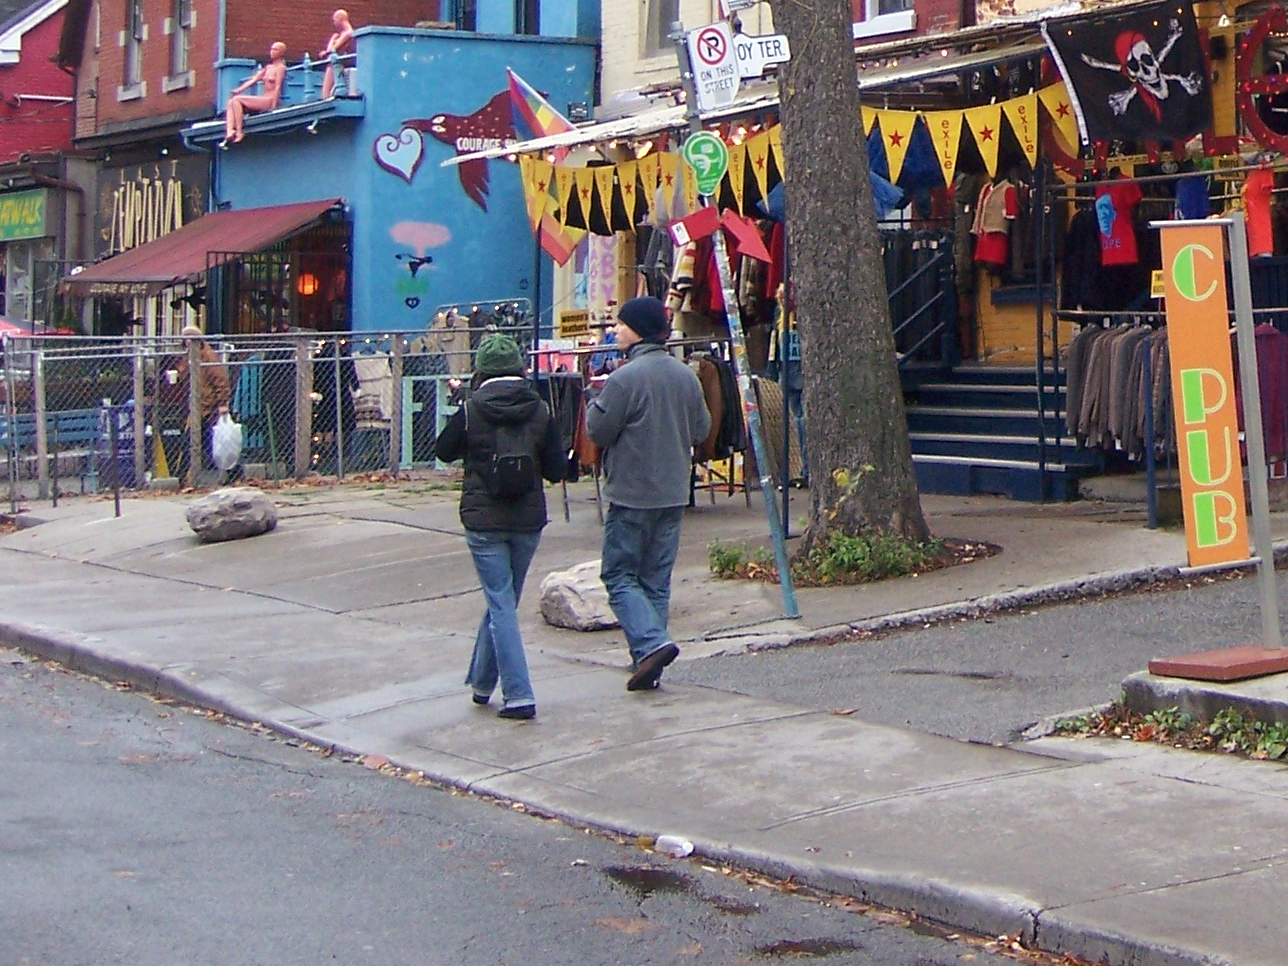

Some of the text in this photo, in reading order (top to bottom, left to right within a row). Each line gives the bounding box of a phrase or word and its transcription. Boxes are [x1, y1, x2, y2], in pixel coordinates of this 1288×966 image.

[758, 38, 786, 59] TER.
[701, 63, 734, 82] ON THIS
[704, 77, 734, 94] STREET
[456, 136, 502, 152] COURAGE
[1172, 244, 1238, 548] C PUB
